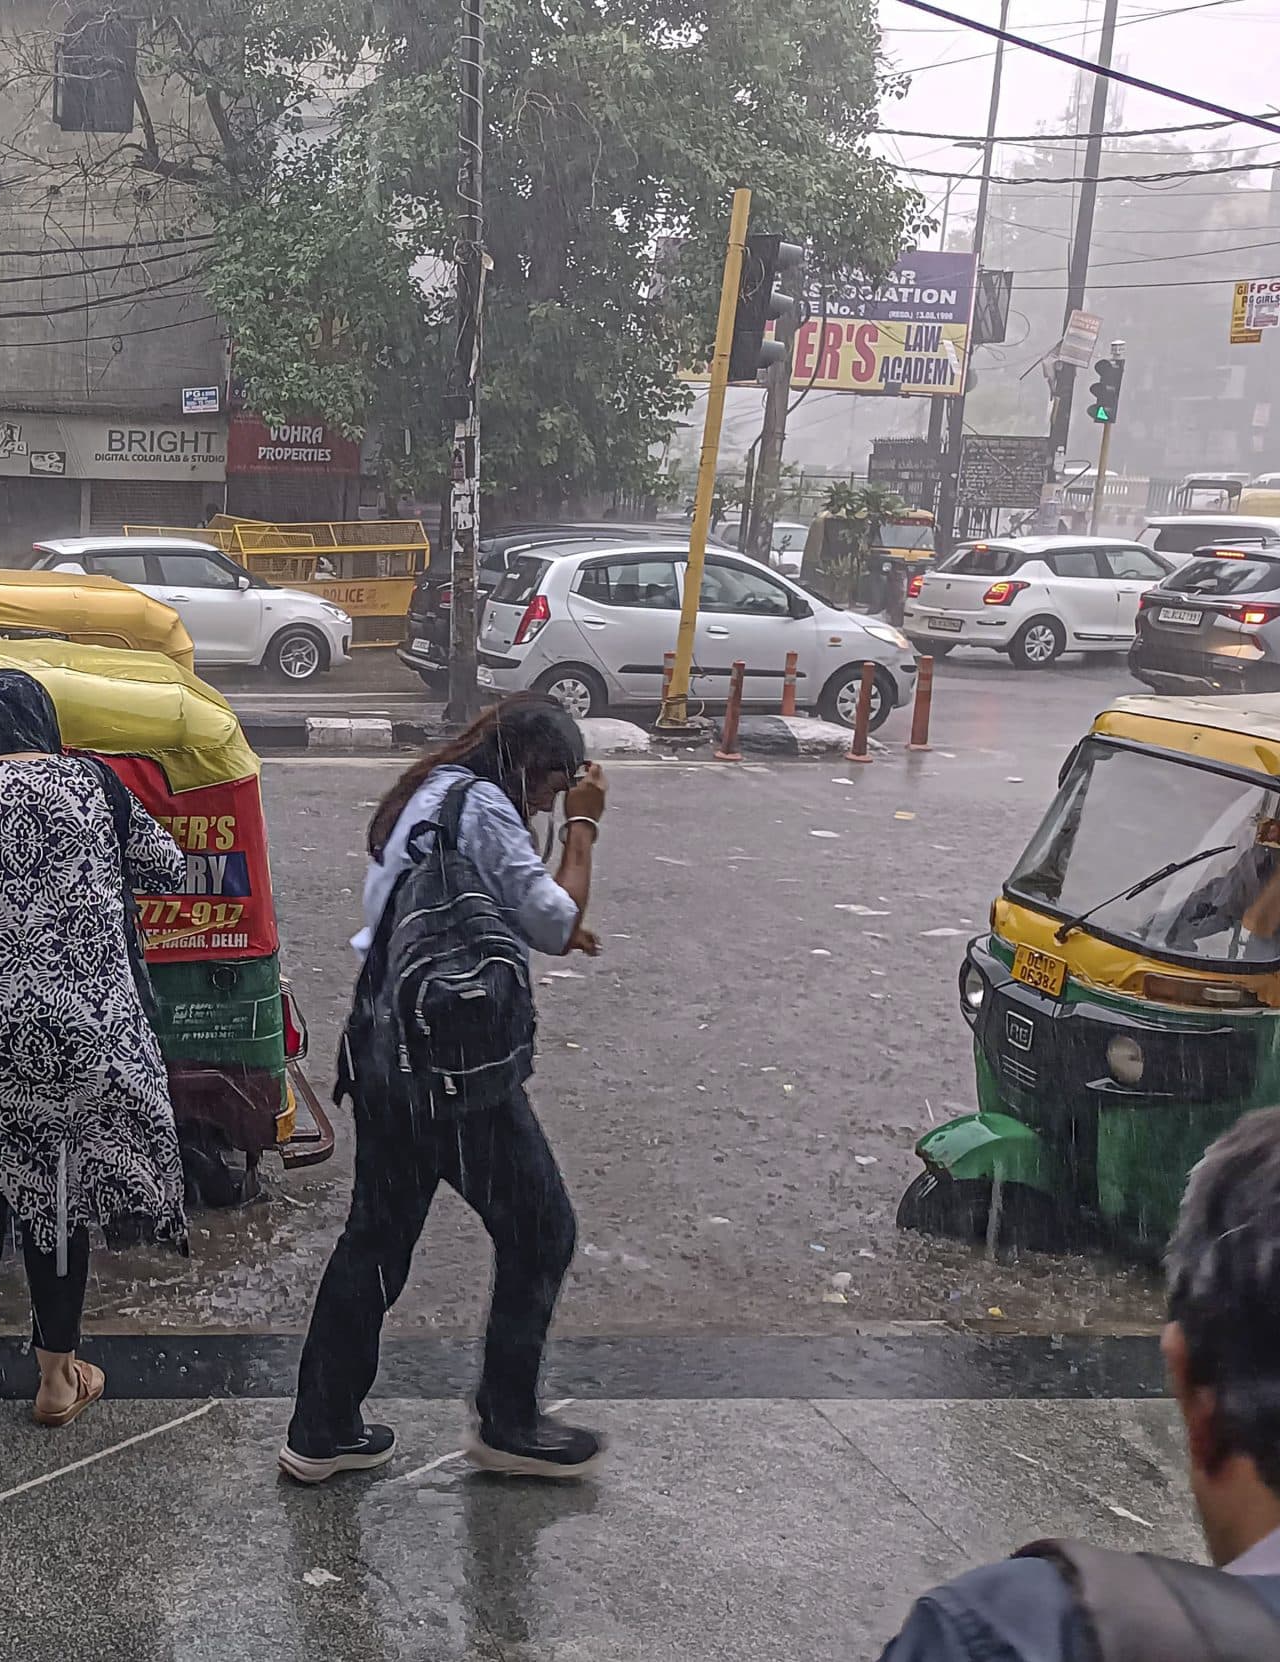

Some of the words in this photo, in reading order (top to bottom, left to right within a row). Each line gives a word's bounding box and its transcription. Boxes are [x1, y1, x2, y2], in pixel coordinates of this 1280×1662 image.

[904, 325, 942, 352] LAW
[108, 430, 219, 454] BRIGHT
[270, 425, 324, 444] VOHRA
[95, 453, 130, 462] DIGITAL
[132, 454, 162, 463] COLOR
[163, 454, 181, 463] LAB
[182, 455, 190, 463] &
[191, 454, 226, 463] STUDIO
[257, 446, 332, 462] PROPERTIES
[323, 587, 365, 603] POLICE
[211, 933, 249, 949] DELHI
